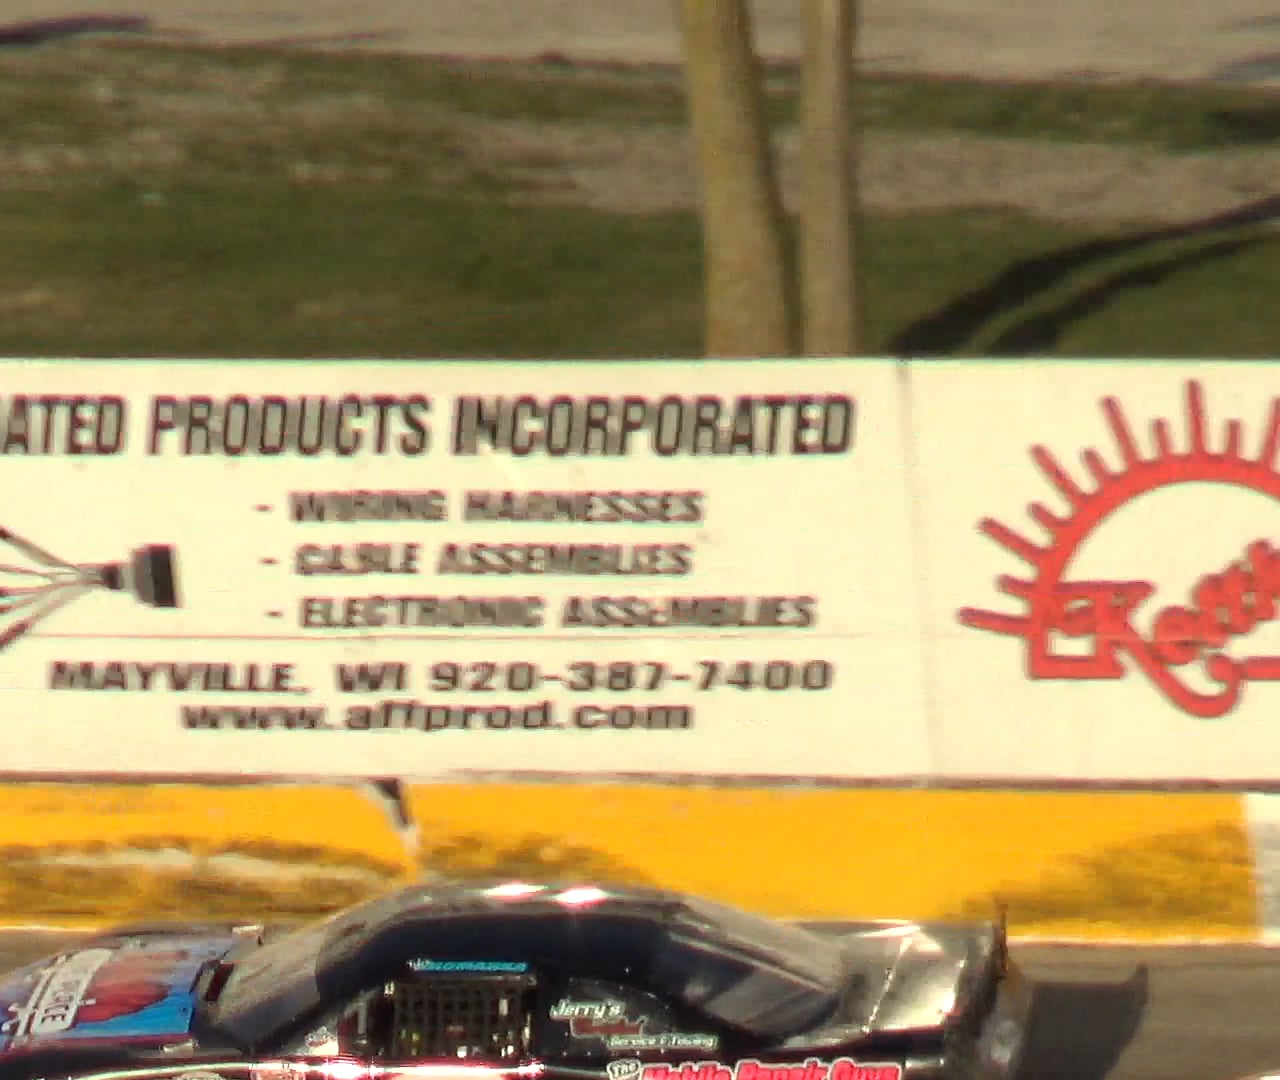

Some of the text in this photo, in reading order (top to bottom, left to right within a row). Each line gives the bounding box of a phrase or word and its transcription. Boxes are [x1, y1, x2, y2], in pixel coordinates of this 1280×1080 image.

[147, 394, 430, 455] PRODUCTS
[453, 394, 855, 456] INCORPORATED
[299, 596, 818, 628] ELECTRONIC ASSEMBLIES
[335, 661, 408, 692] WI
[428, 660, 834, 692] 920-387-7400
[181, 699, 694, 731] www.affprod.com
